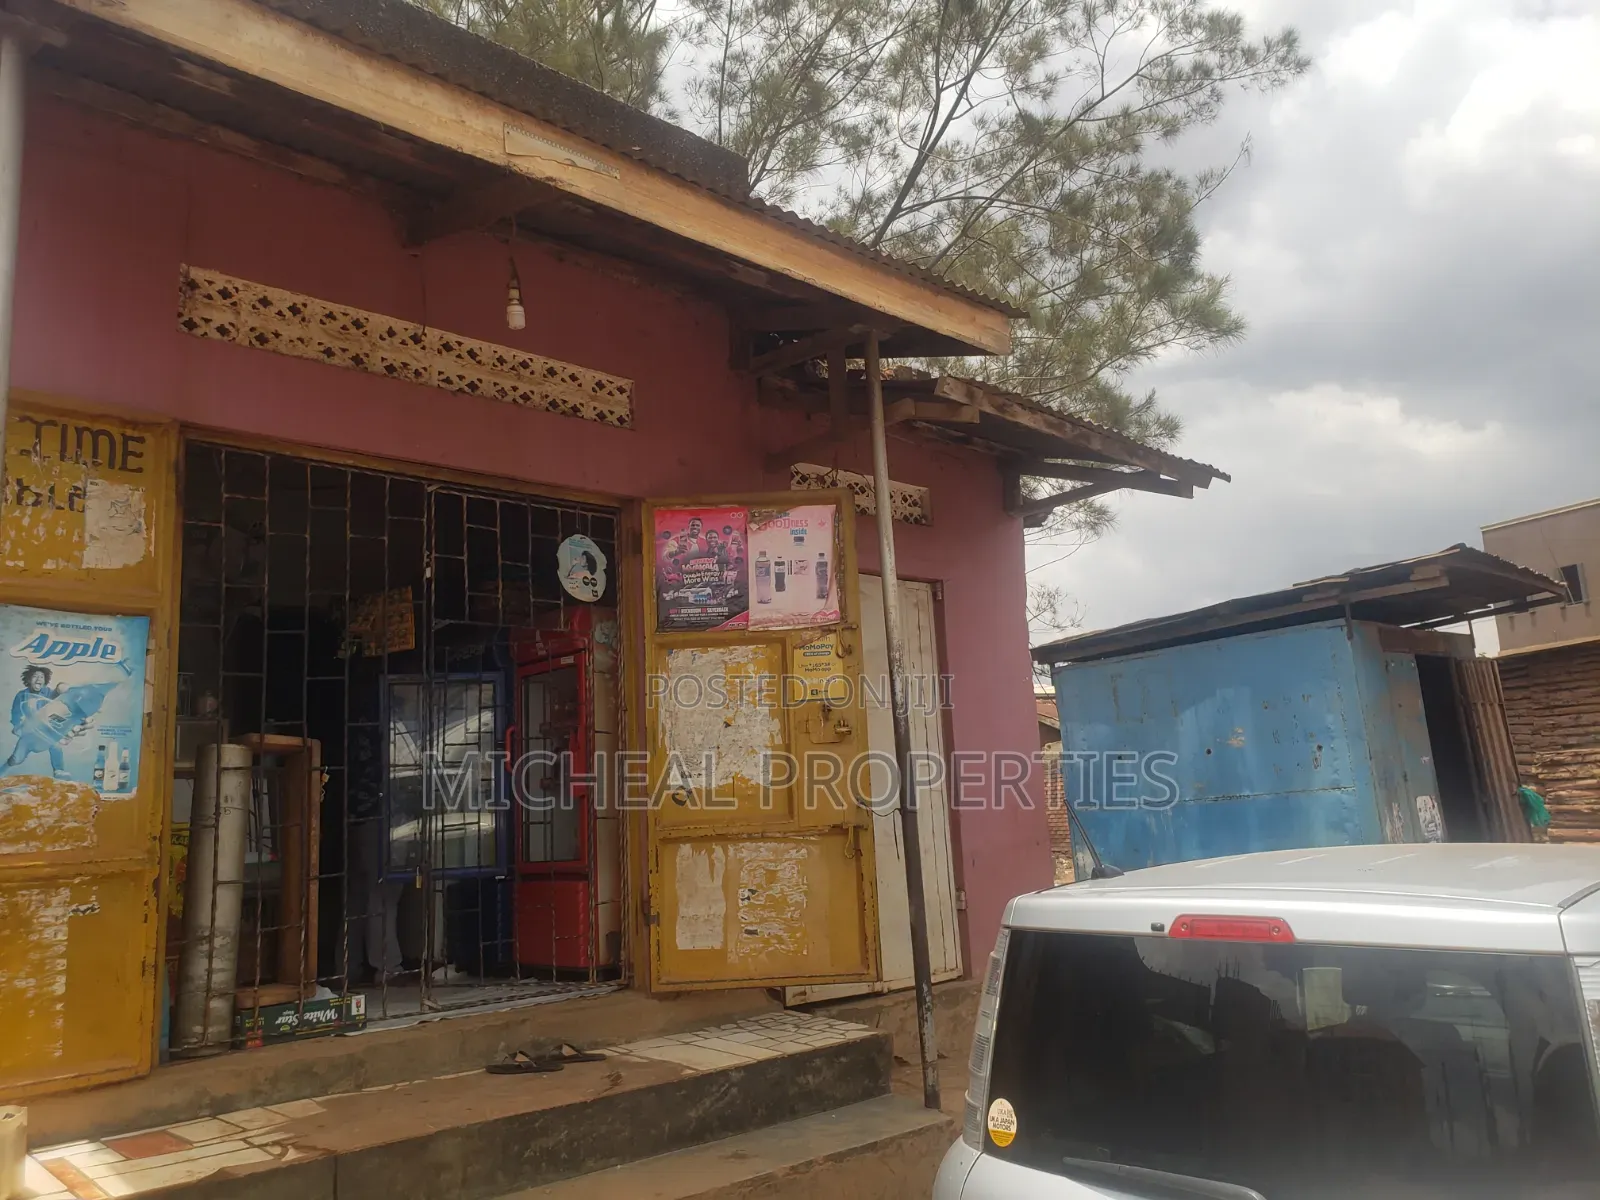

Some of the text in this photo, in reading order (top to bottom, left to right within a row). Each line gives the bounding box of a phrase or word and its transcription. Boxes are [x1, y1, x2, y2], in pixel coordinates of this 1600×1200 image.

[16, 414, 146, 474] TIME
[18, 633, 118, 661] Apple
[274, 1008, 338, 1026] White Star
